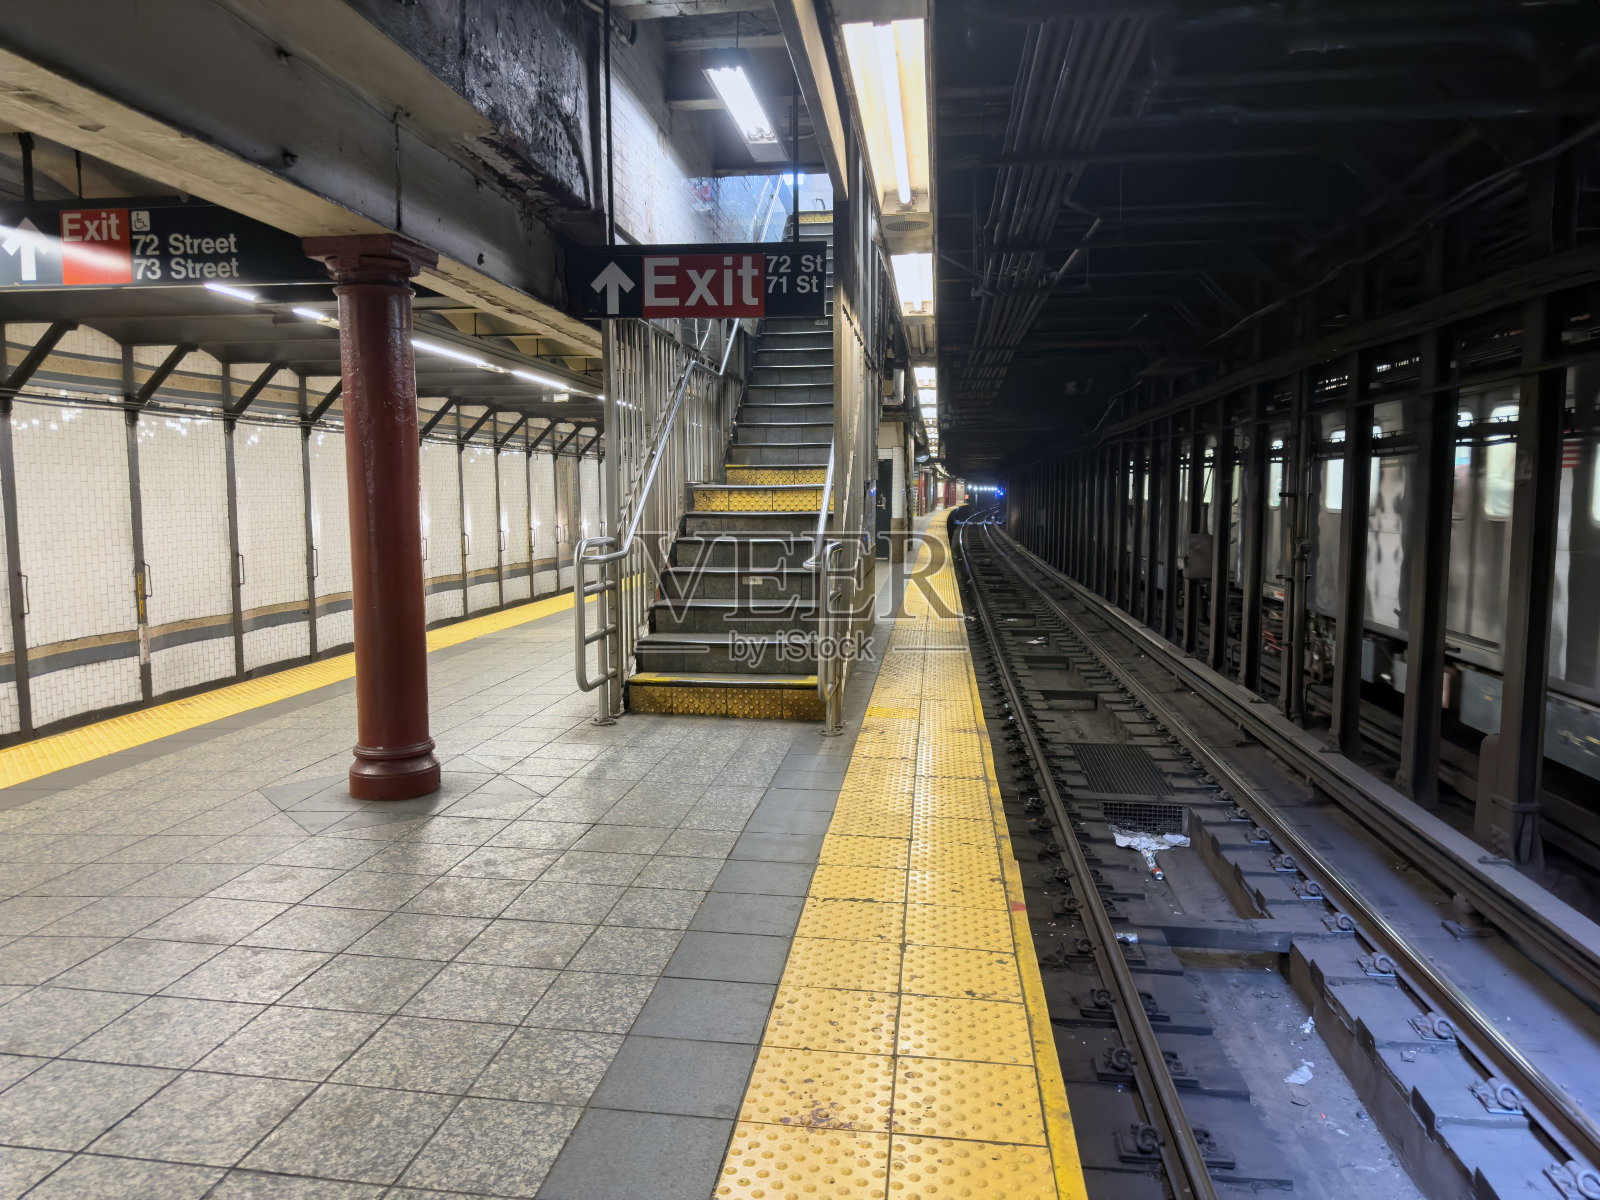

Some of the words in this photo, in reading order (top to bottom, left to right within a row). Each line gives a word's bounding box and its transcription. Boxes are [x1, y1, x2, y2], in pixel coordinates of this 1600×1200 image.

[63, 212, 120, 242] Exit
[132, 235, 160, 256] 72
[168, 233, 238, 255] Street
[133, 259, 161, 280] 73
[170, 257, 239, 279] Street
[766, 255, 791, 273] 72
[801, 254, 823, 273] St
[644, 256, 759, 307] Exit
[766, 276, 788, 294] 71
[796, 275, 819, 293] St
